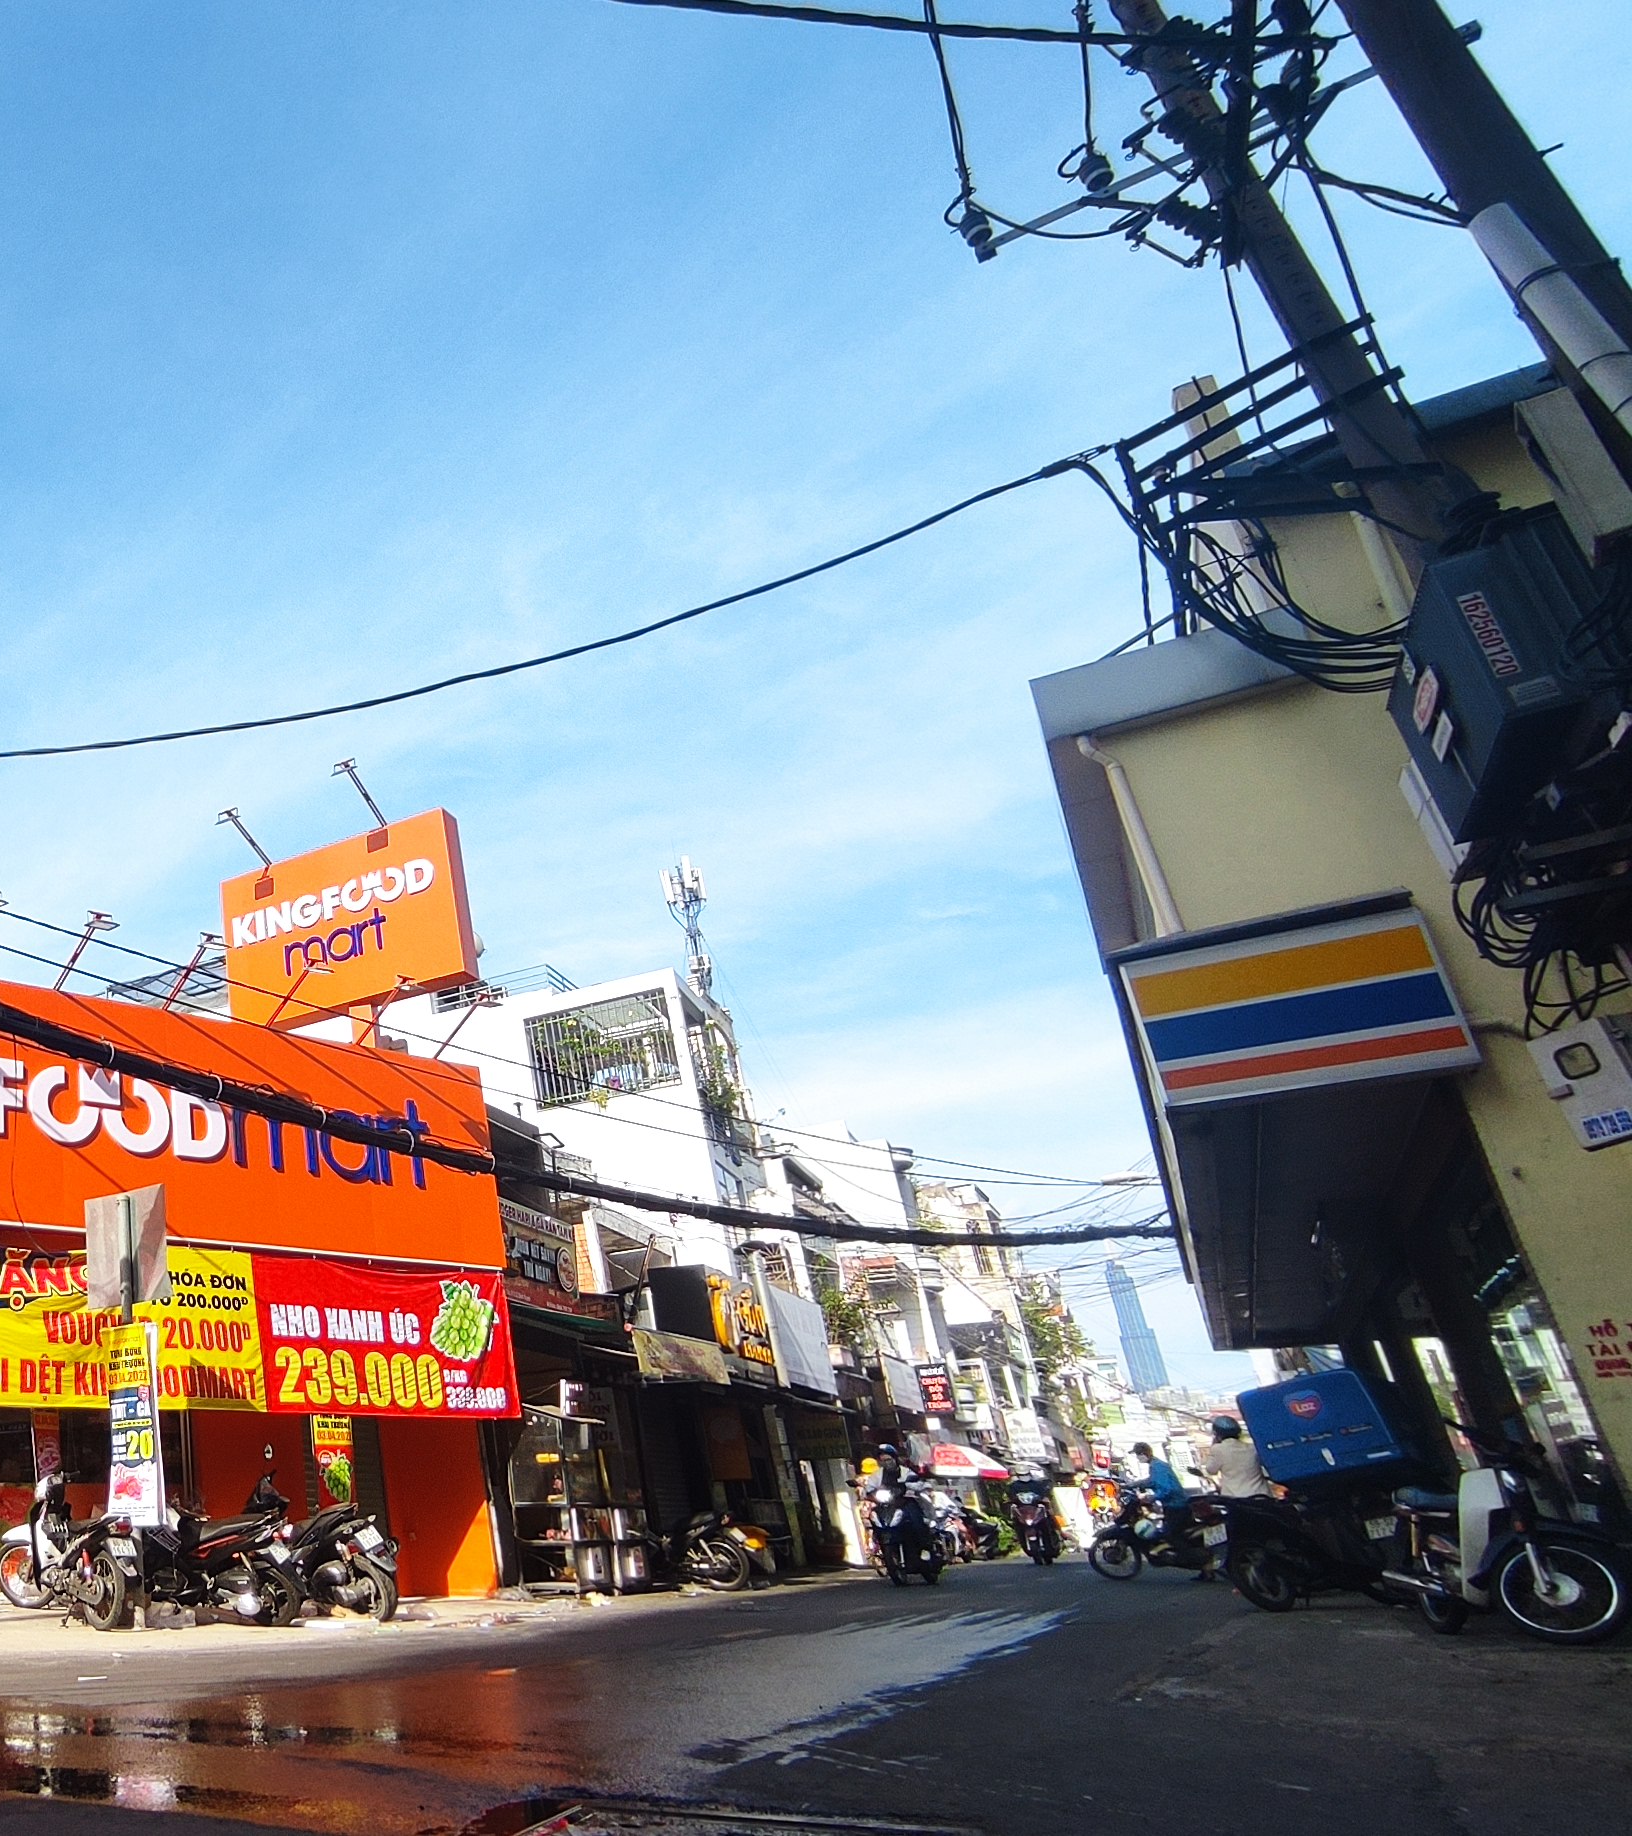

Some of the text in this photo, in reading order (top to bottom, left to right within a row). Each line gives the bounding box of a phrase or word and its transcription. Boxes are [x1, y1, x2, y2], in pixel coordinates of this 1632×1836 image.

[1459, 594, 1519, 676] 162560120
[231, 858, 435, 948] KINGFOOD
[284, 908, 387, 976] mart
[168, 1268, 247, 1292] HÓA ĐƠN
[42, 1310, 152, 1347] VOUC
[269, 1303, 421, 1345] NHO XANH ÚC
[20, 1353, 67, 1401] DỆT
[274, 1346, 444, 1409] 239.000
